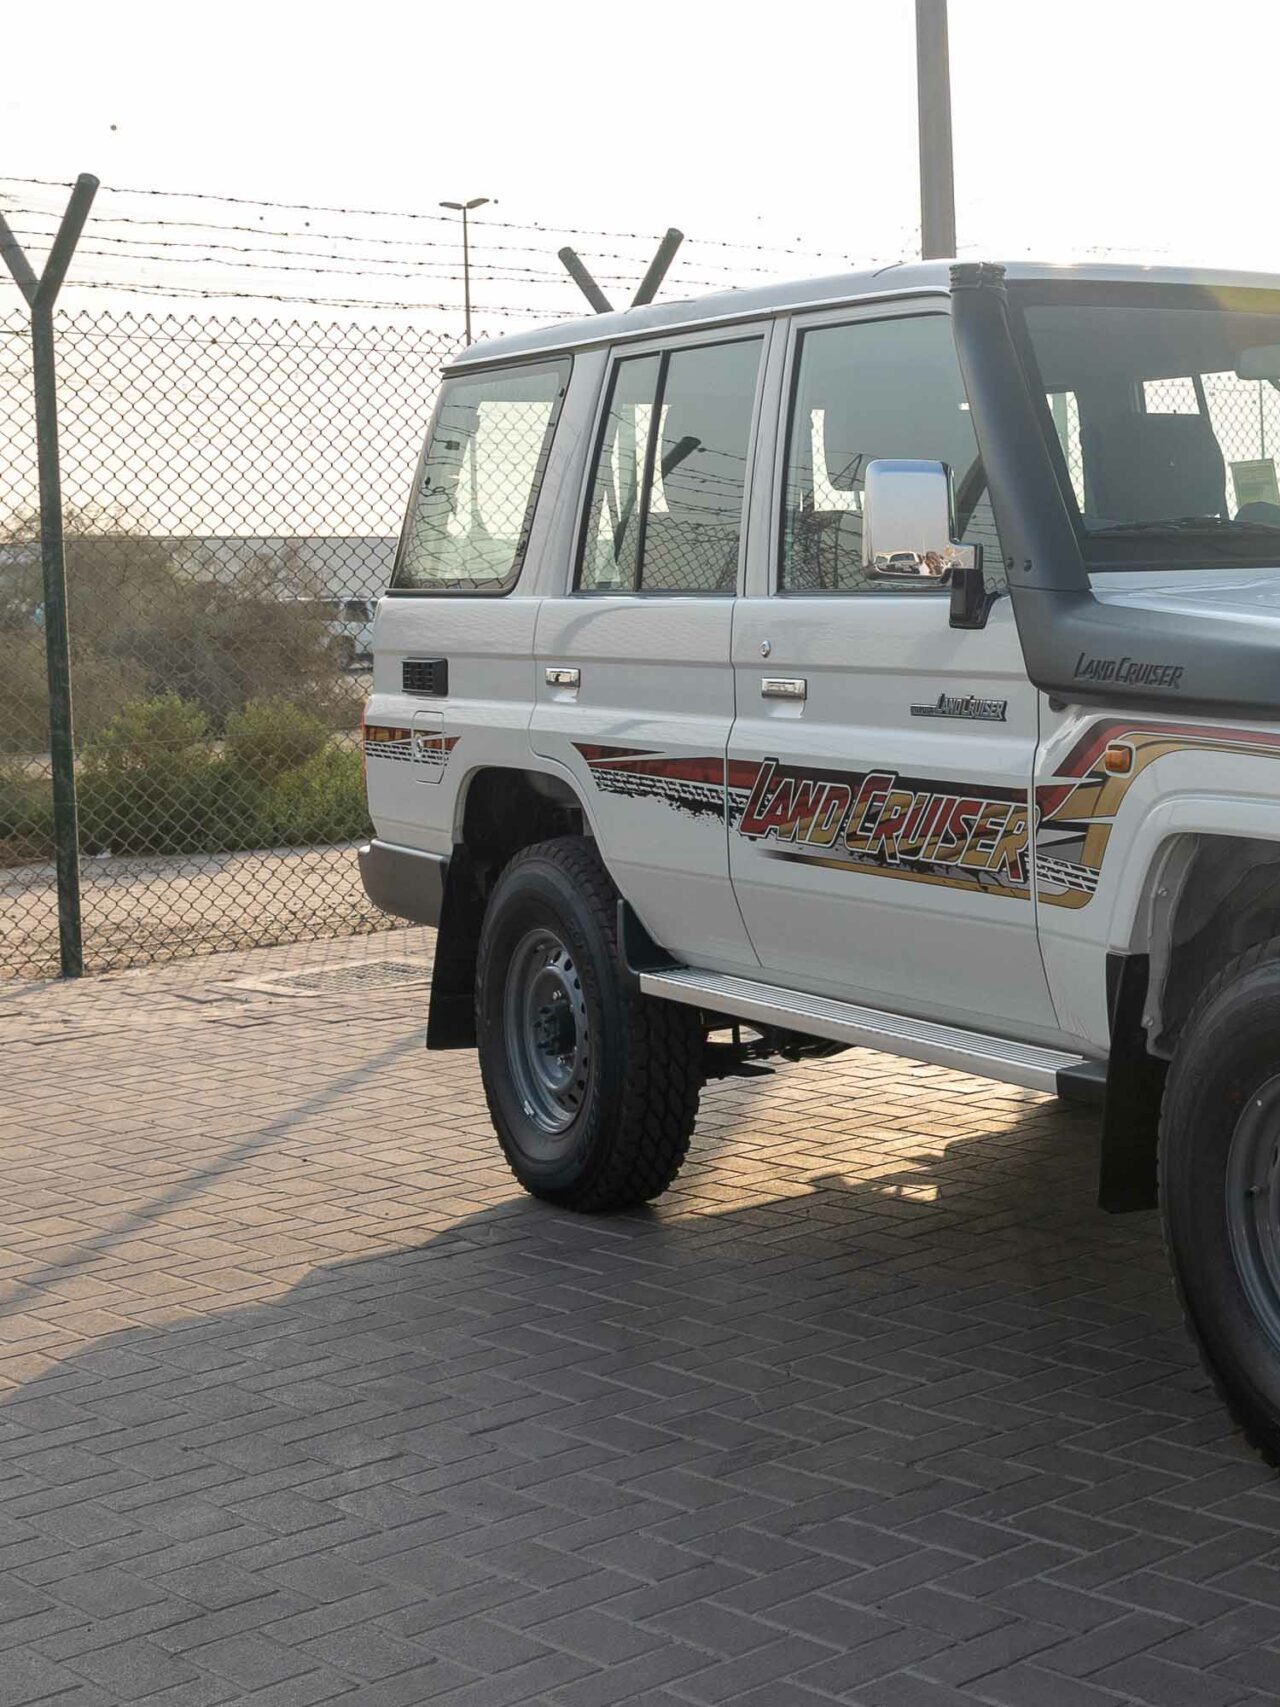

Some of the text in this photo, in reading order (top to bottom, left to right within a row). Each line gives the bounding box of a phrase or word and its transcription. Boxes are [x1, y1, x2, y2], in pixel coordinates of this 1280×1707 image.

[1073, 652, 1184, 689] LAND CRUISER
[739, 757, 1042, 884] LAND CRUISER
